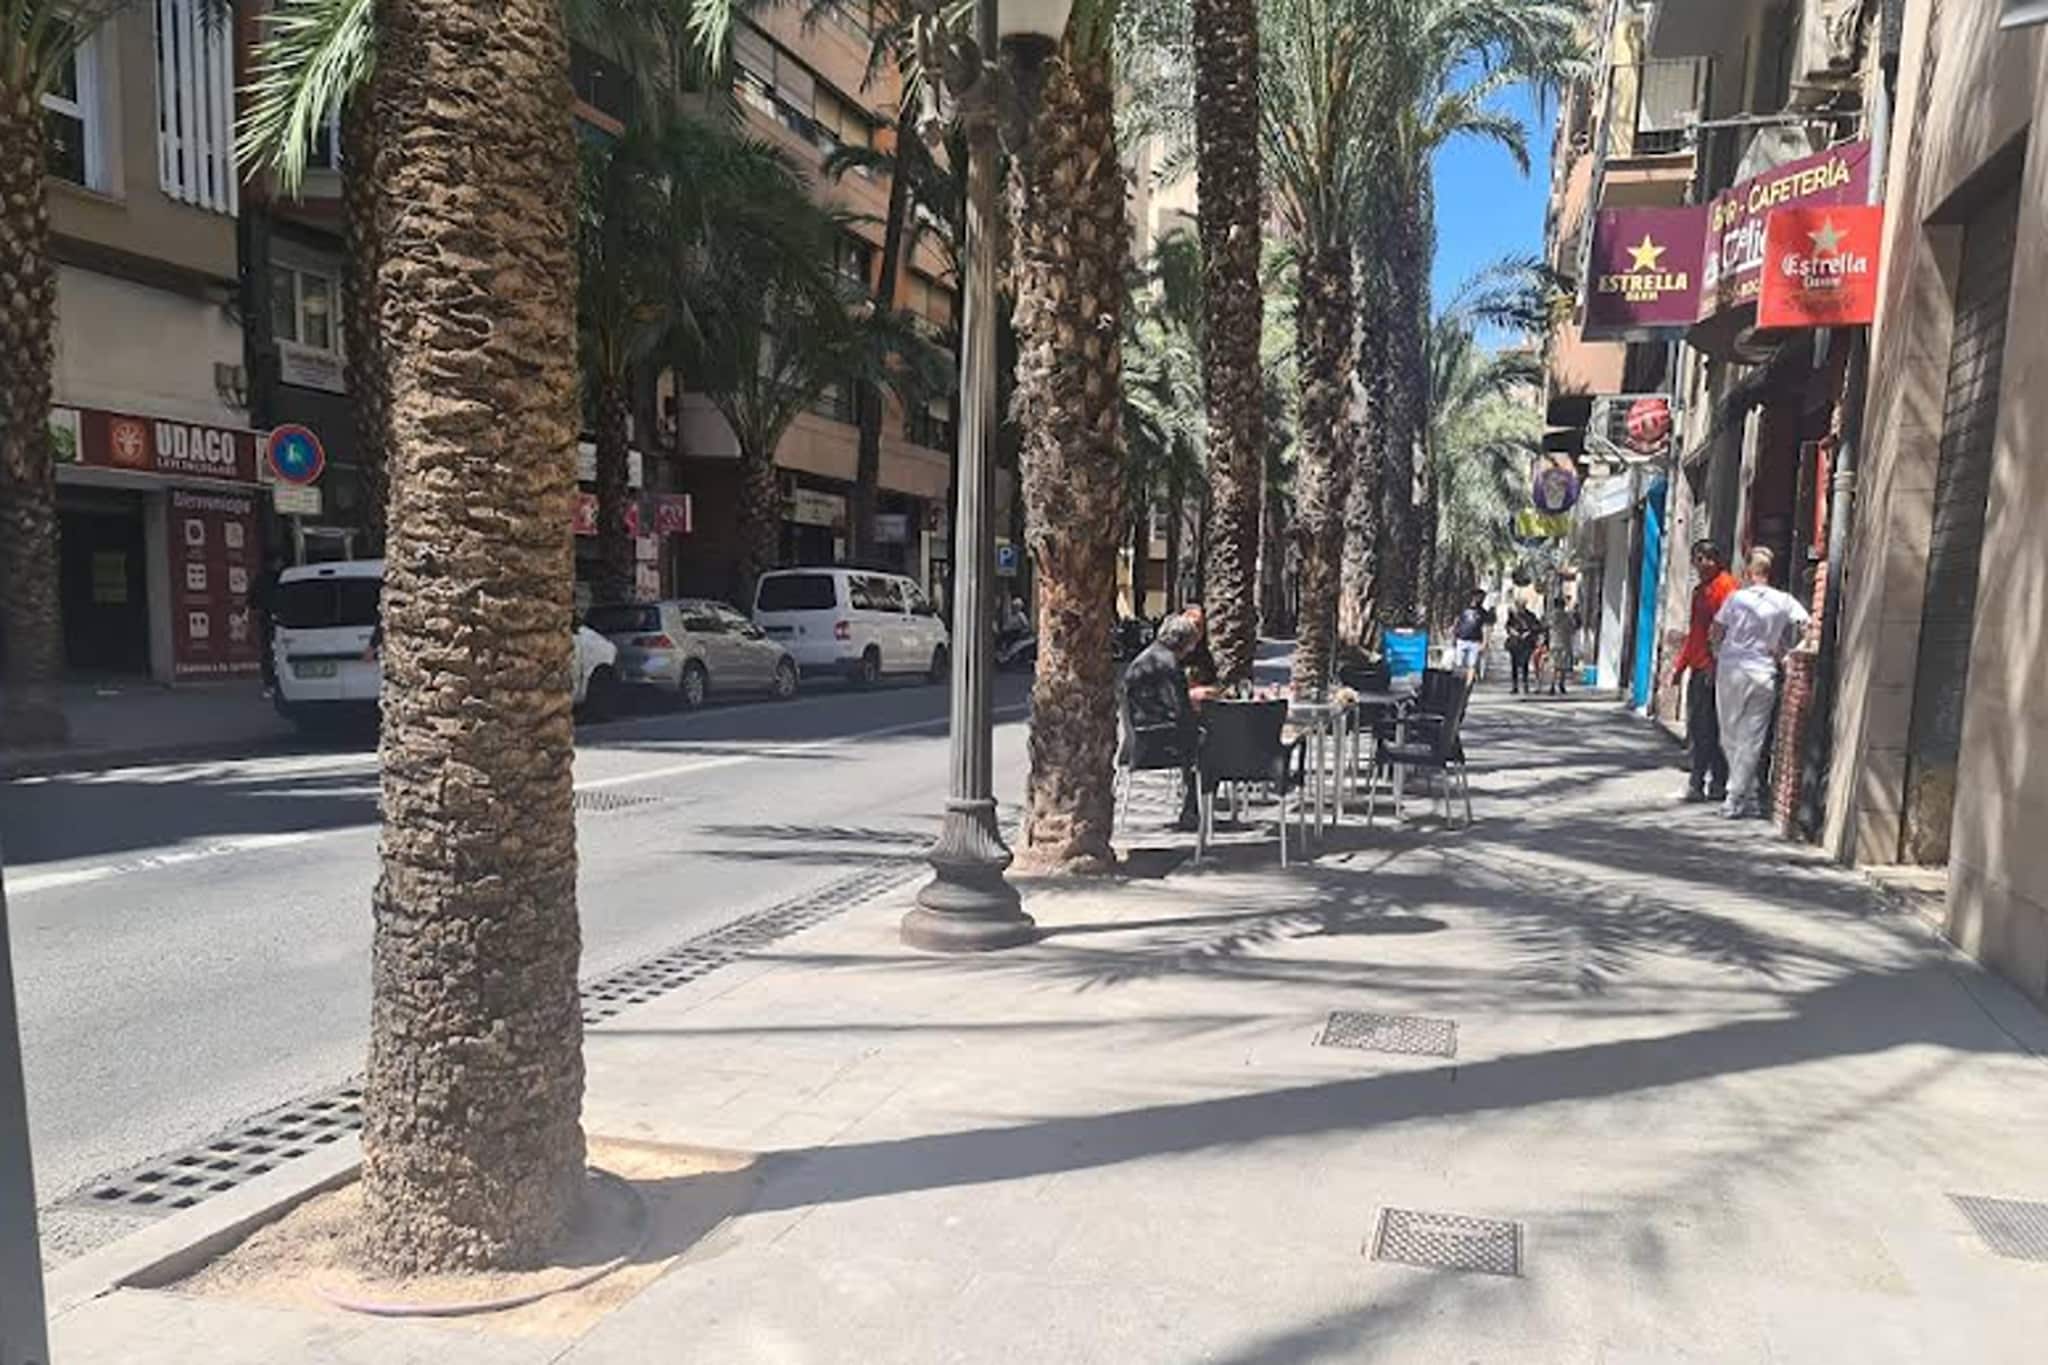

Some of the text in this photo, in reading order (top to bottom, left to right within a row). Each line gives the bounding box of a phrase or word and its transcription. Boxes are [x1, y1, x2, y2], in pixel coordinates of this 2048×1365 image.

[1748, 157, 1850, 215] CAFETERÍA
[1781, 252, 1868, 276] Estrella
[1598, 272, 1688, 293] ESTRELLA
[155, 422, 236, 465] UDACO
